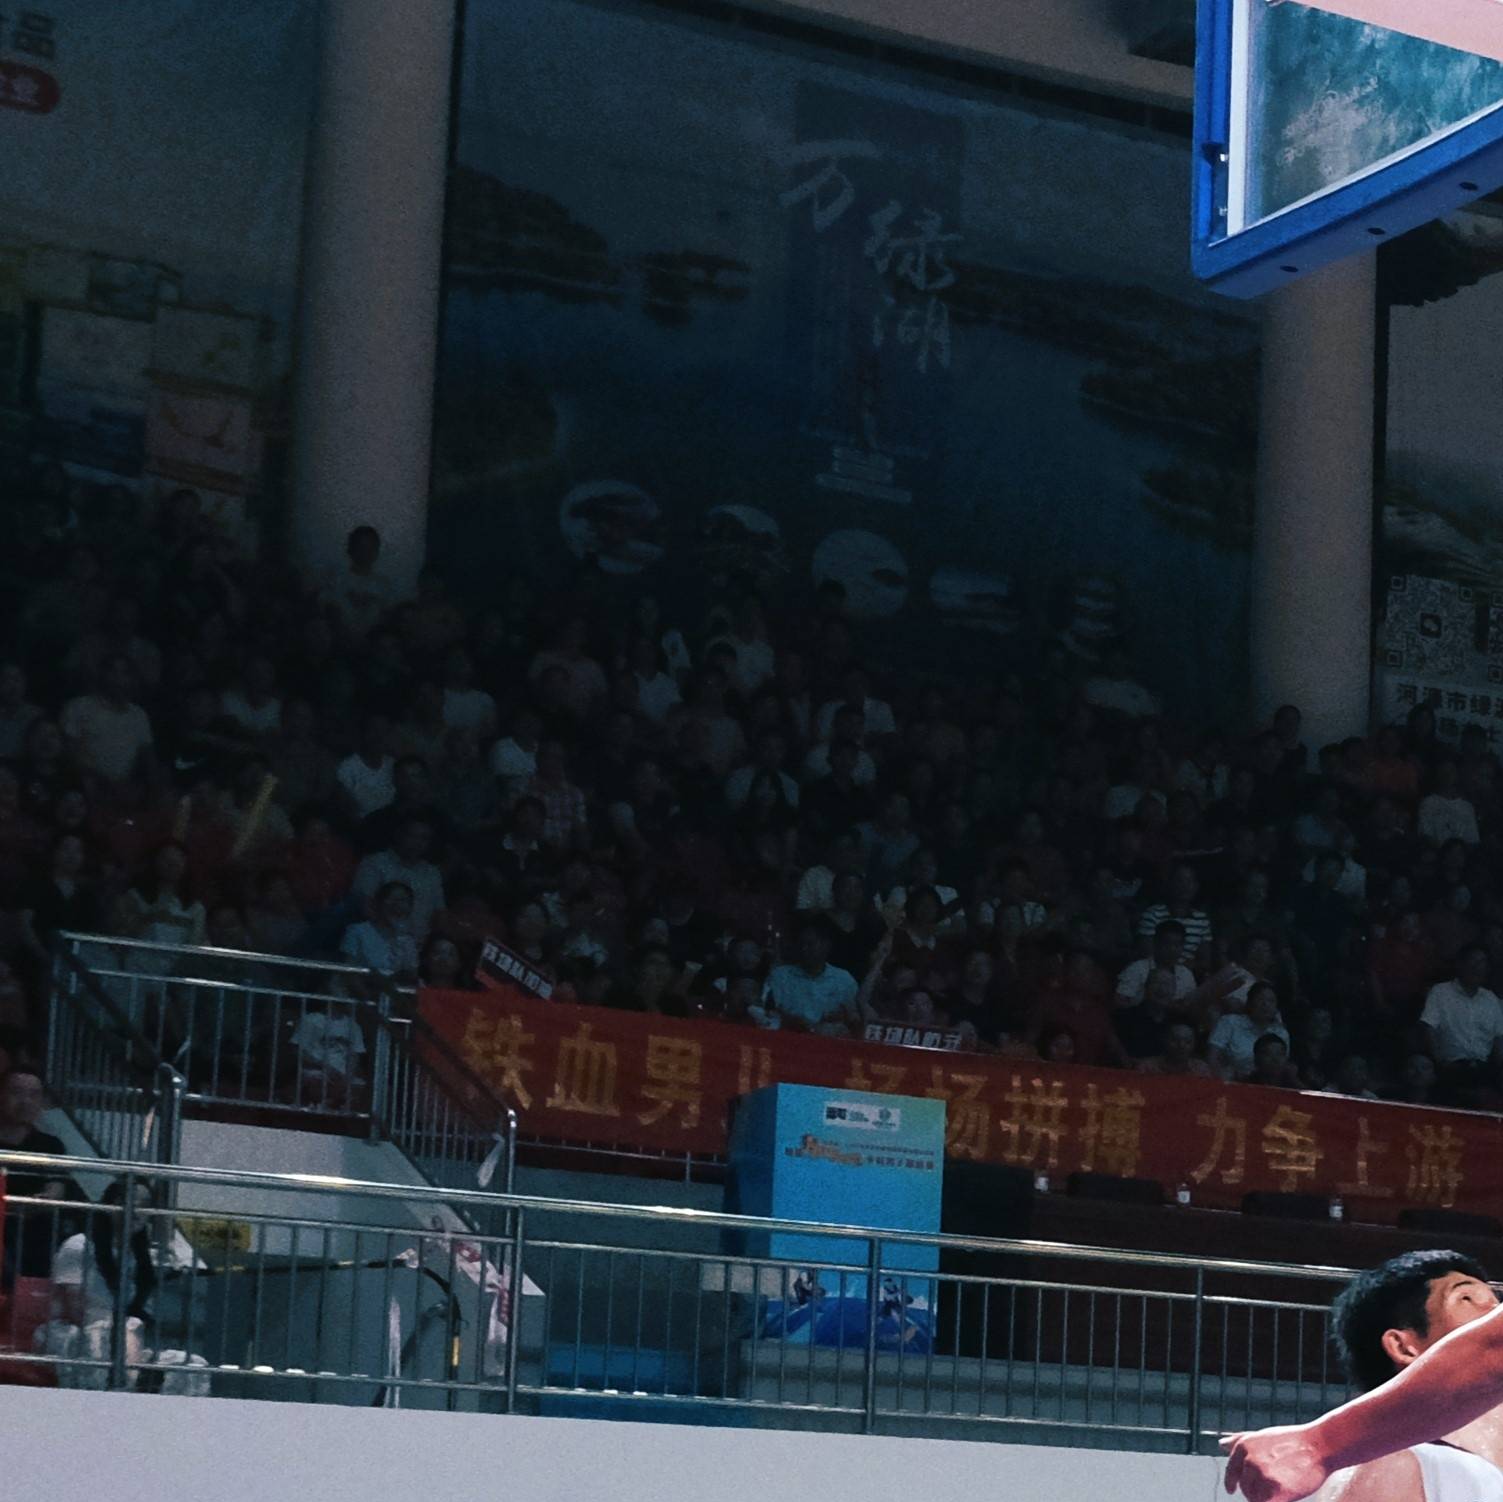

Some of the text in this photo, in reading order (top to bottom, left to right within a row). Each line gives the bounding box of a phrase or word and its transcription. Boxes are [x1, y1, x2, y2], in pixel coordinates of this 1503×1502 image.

[780, 138, 965, 376] 万绿湖
[1190, 1094, 1467, 1210] 力争上游
